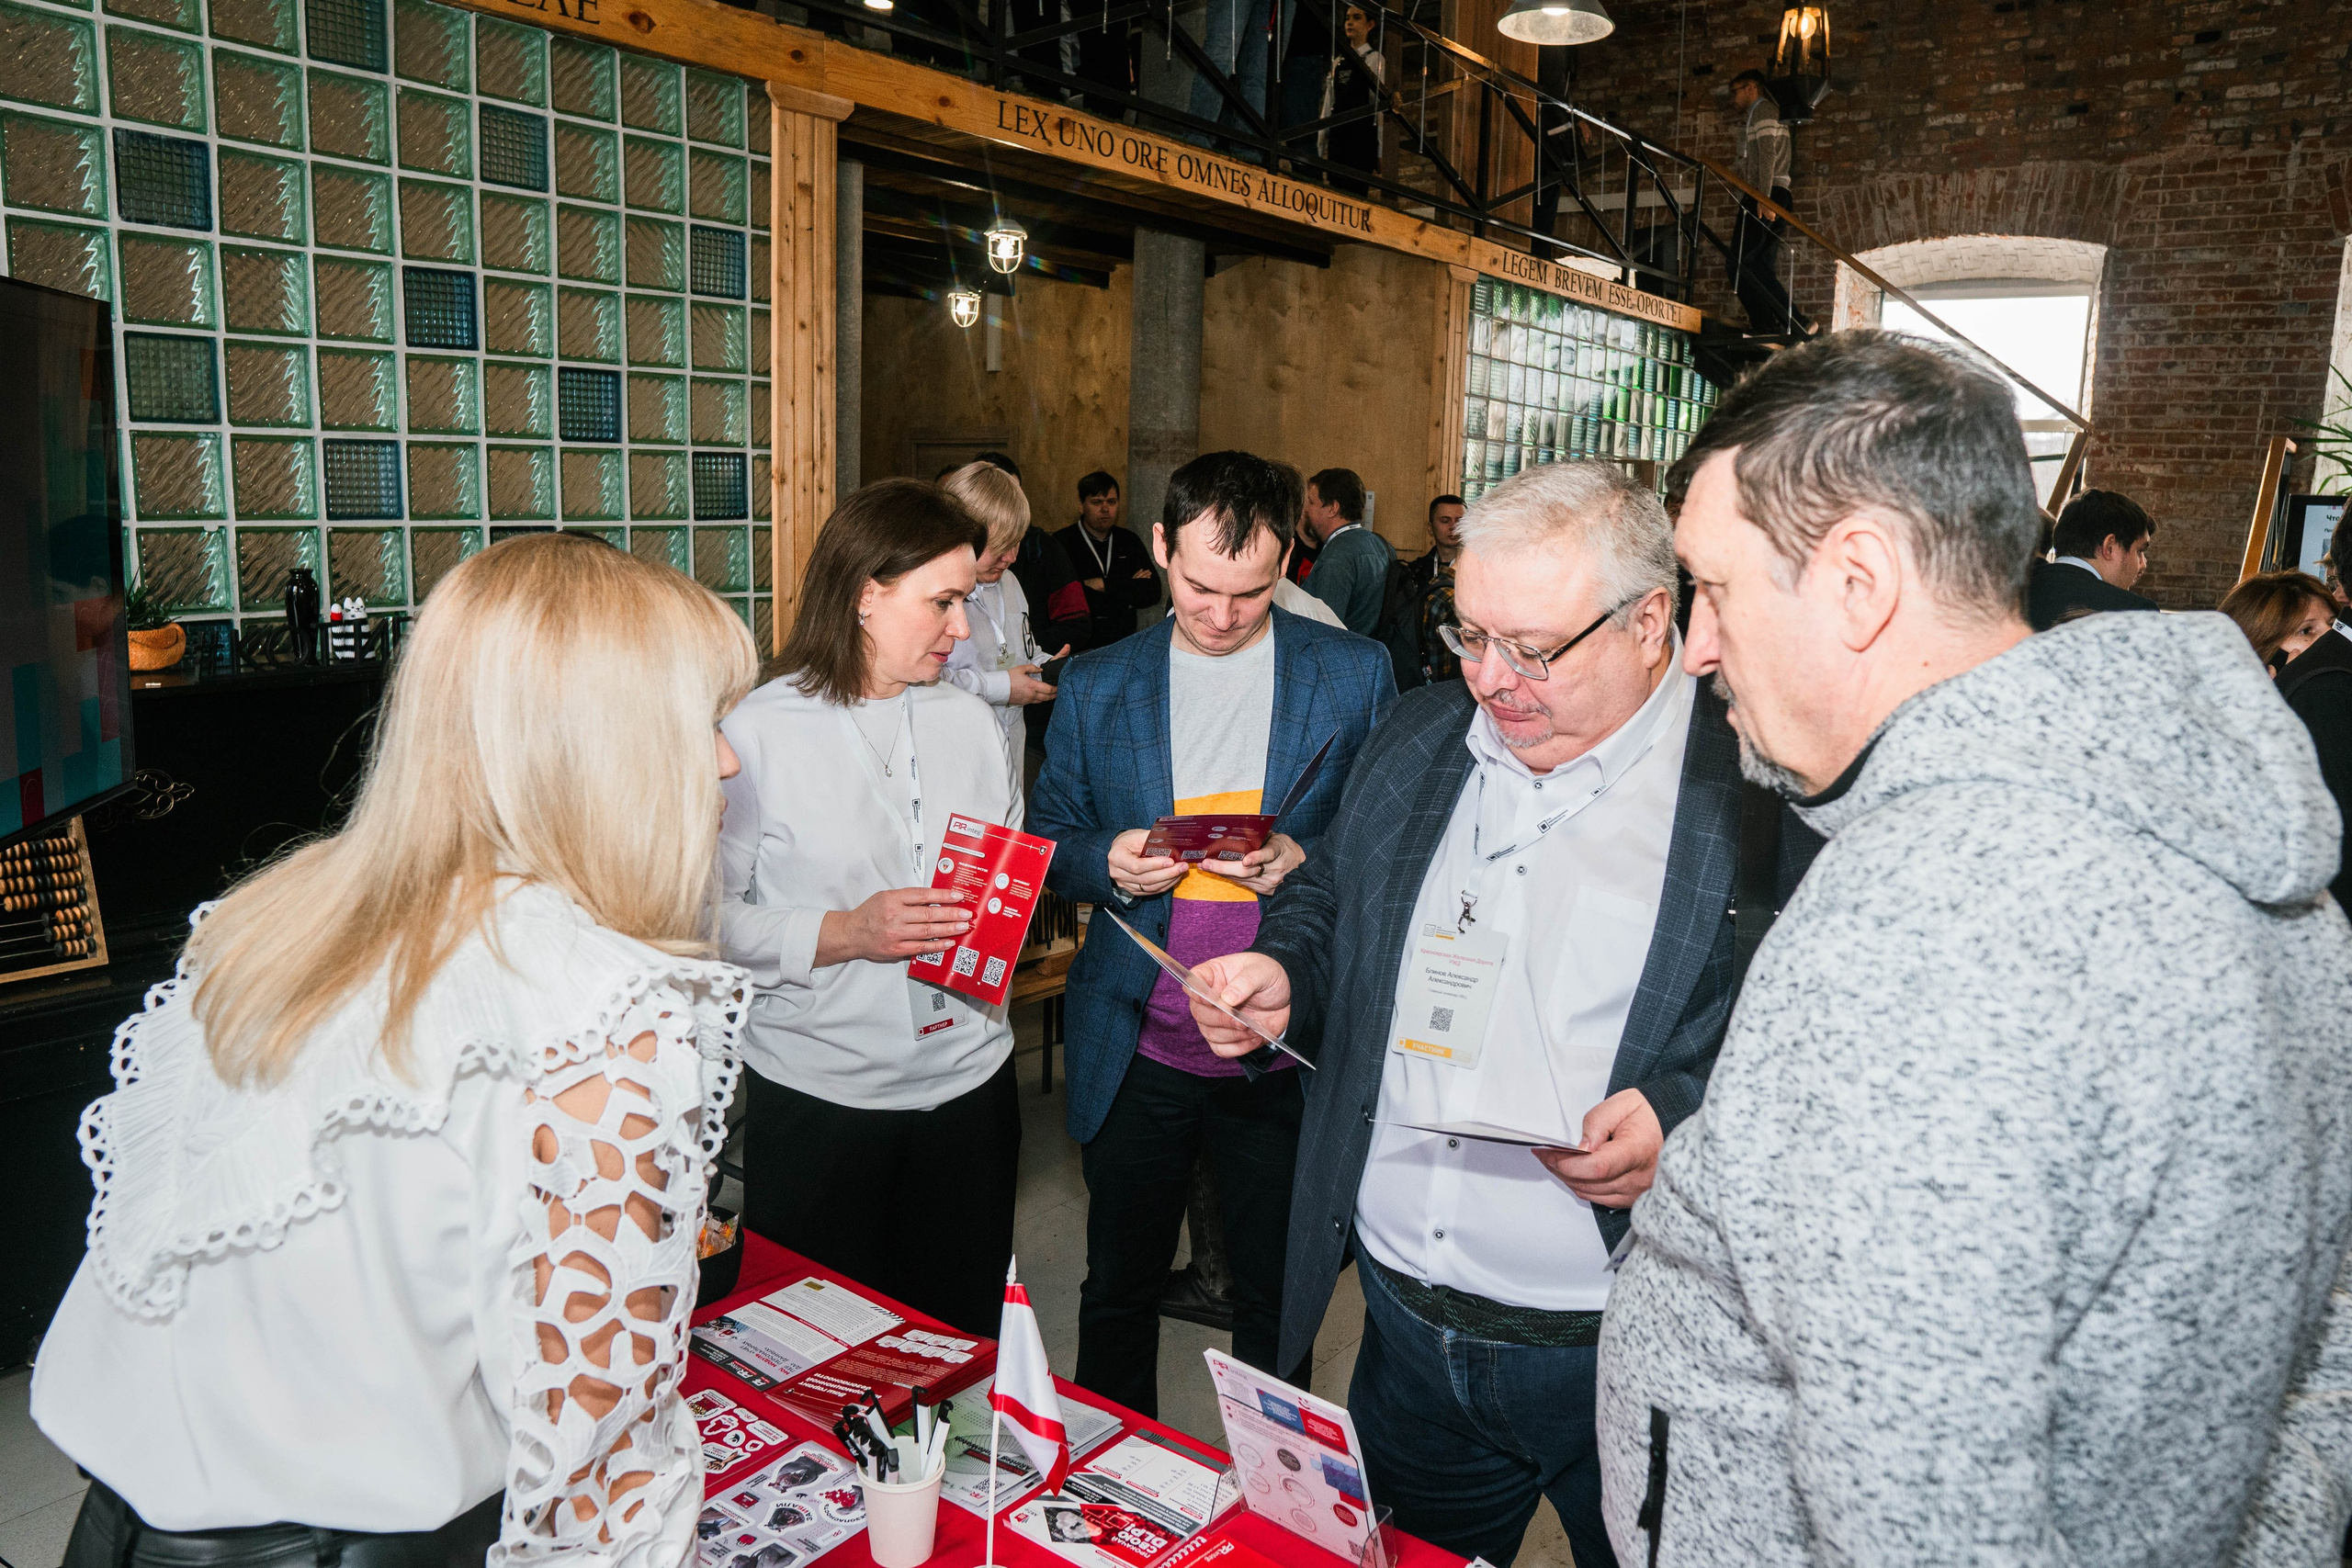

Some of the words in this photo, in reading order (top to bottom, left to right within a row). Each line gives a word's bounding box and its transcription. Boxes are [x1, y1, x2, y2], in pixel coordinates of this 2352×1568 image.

[998, 99, 1049, 141] LEX
[1057, 117, 1114, 157] UNO
[1123, 138, 1168, 174] ORE
[1177, 153, 1251, 197] OMNES
[1257, 176, 1372, 232] ALLOQUITUR
[1502, 252, 1547, 285] LEGEM
[1555, 268, 1602, 300] BREVEM
[1609, 285, 1633, 310] ESSE
[1637, 294, 1683, 324] OPORTET
[1427, 976, 1472, 989] Александрович
[1446, 971, 1478, 983] Александр
[930, 1021, 947, 1031] ПАРТНЕР
[1412, 1043, 1445, 1055] УЧАСТНИК
[797, 1380, 827, 1392] гарант
[825, 1387, 846, 1398] Ваш
[775, 1503, 812, 1521] ЗАИБАЛИ
[1116, 1529, 1159, 1554] СВОЮ
[1123, 1520, 1169, 1550] DLP!
[1110, 1535, 1151, 1559] ПРОКАЧАЙ
